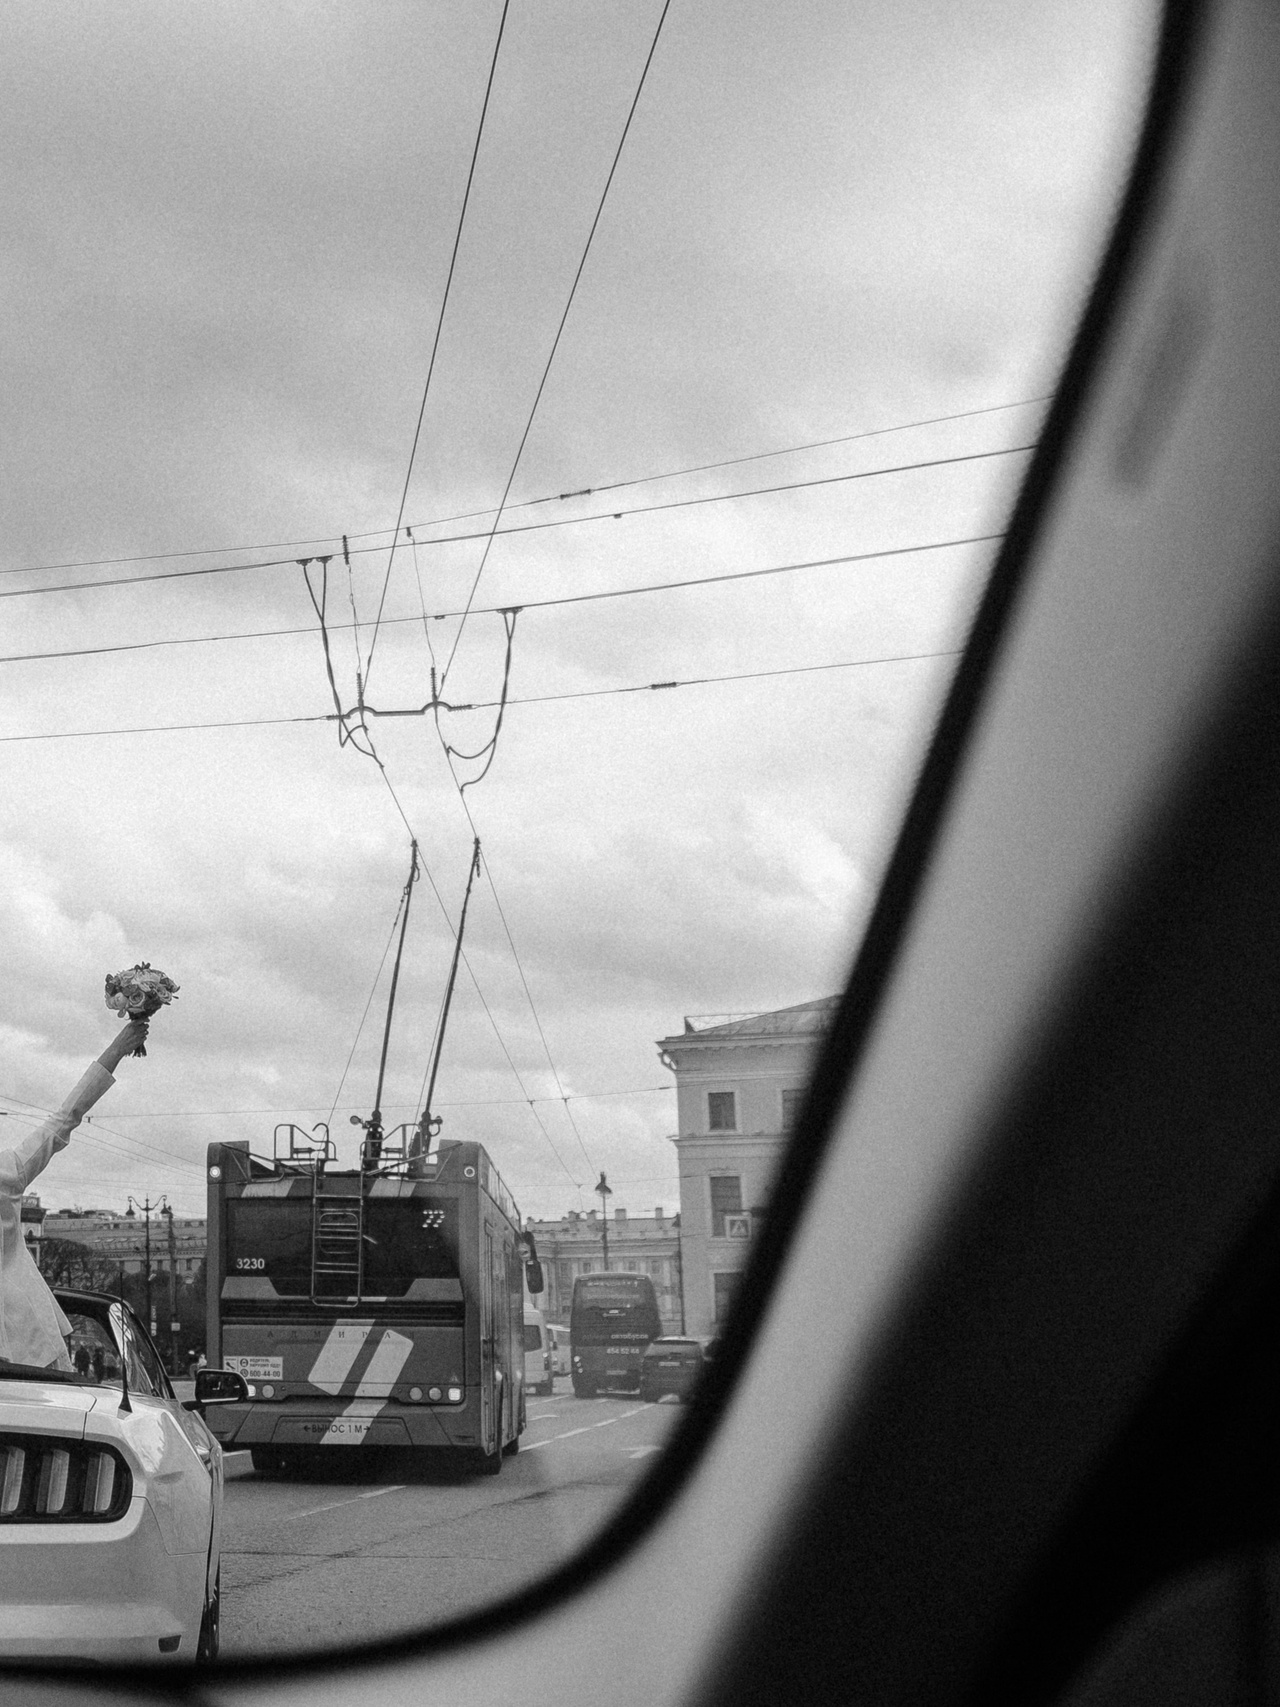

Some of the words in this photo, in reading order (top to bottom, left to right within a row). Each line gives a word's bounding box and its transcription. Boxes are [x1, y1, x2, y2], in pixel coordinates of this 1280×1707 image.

[236, 1258, 265, 1269] 3230
[312, 1424, 345, 1433] ВЫНОС
[354, 1424, 362, 1433] М
